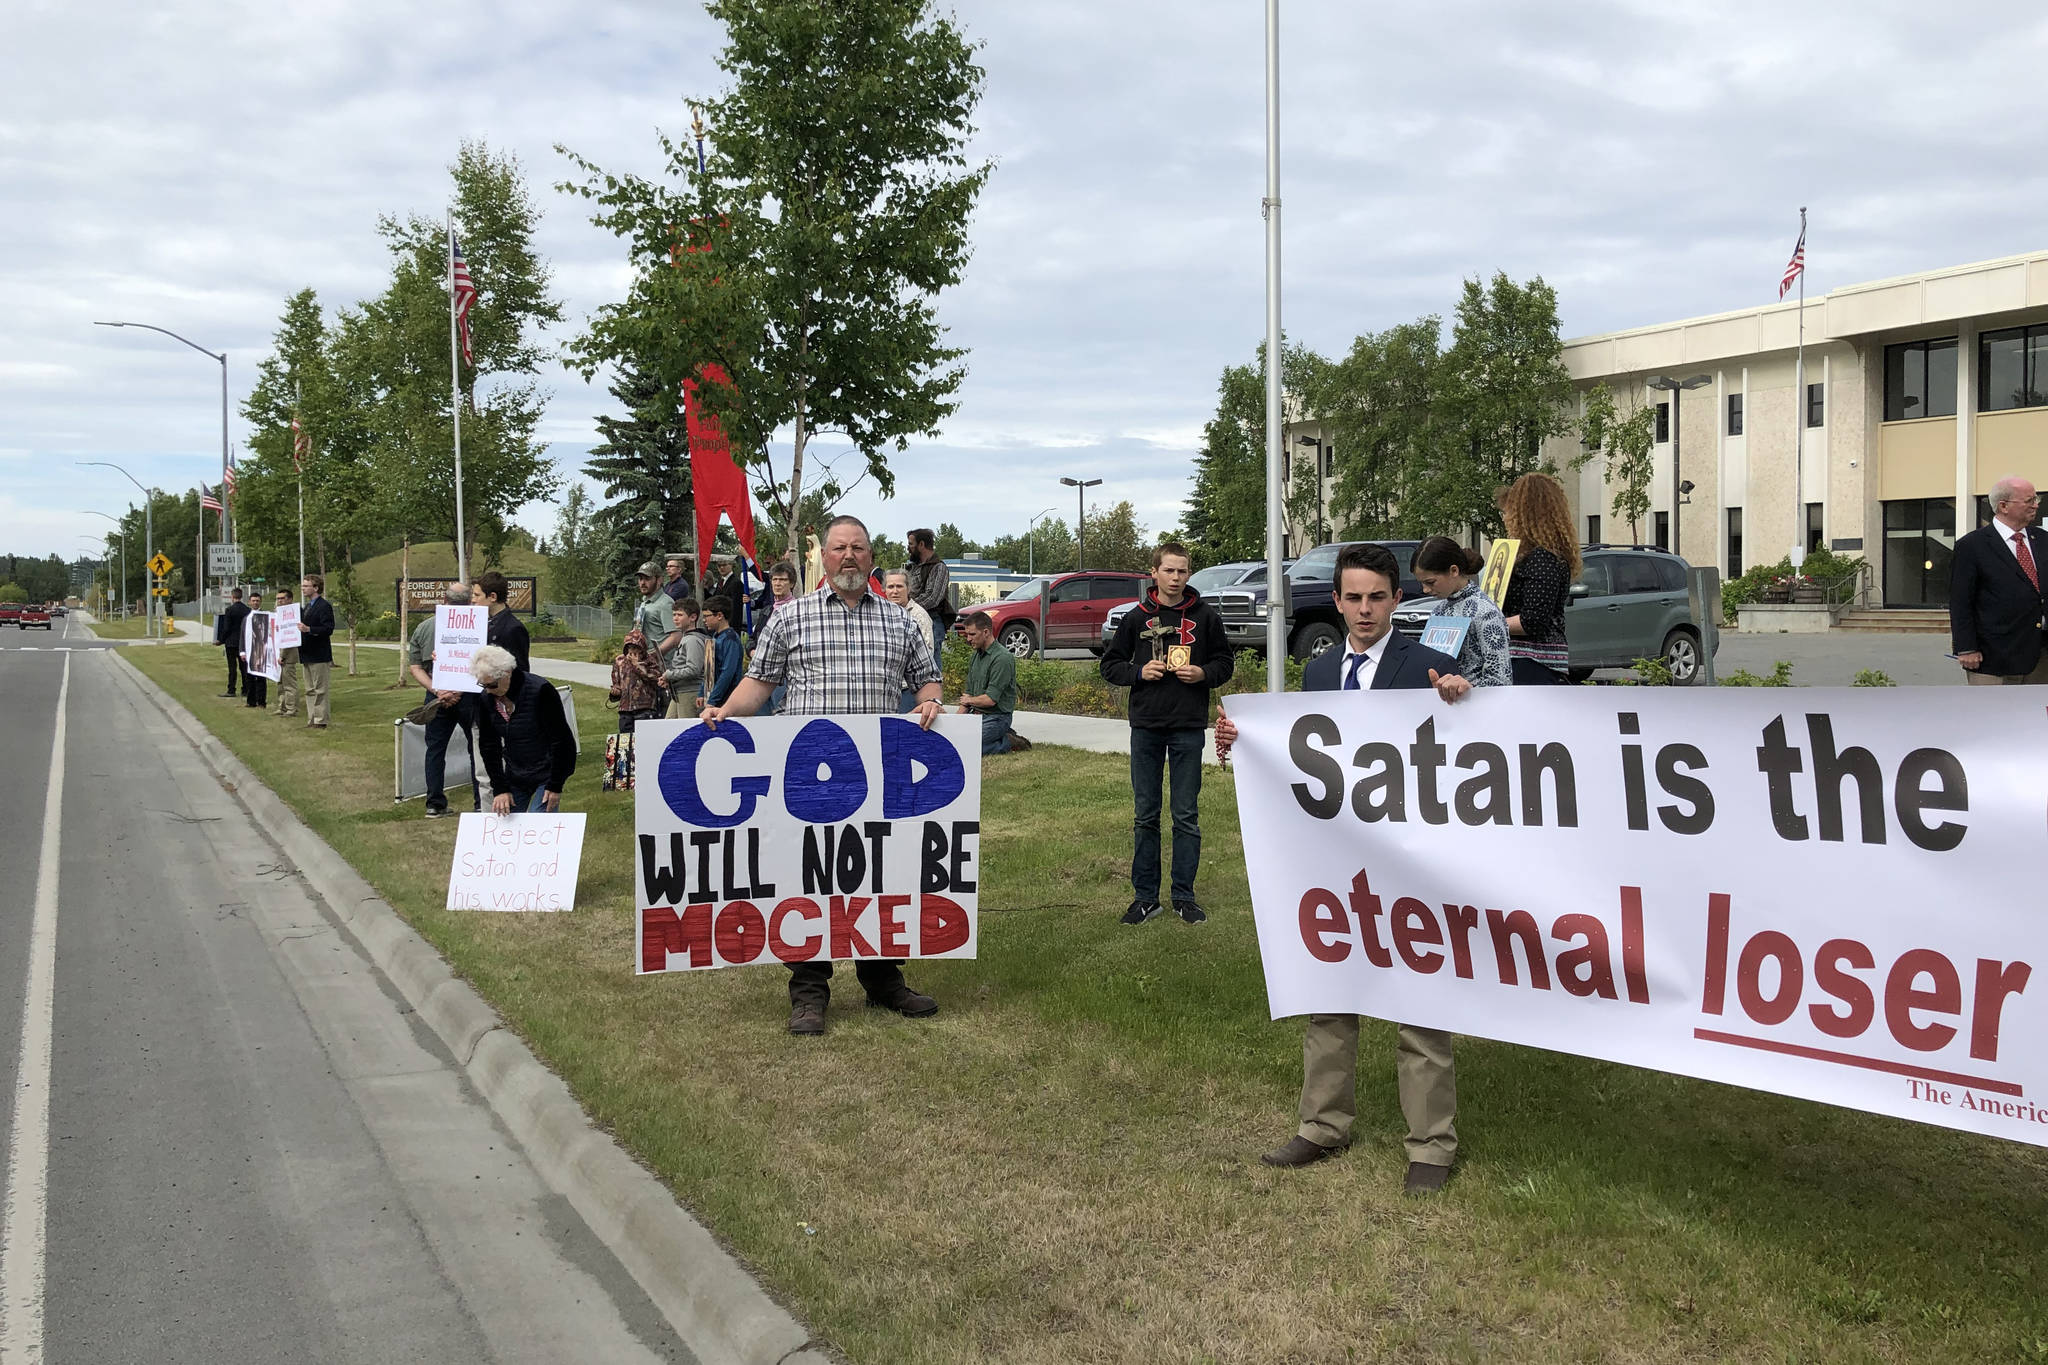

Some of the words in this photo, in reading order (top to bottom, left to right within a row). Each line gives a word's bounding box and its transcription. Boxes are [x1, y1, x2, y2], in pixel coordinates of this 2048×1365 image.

[402, 582, 436, 591] EORGE
[447, 608, 477, 630] Honk
[1427, 629, 1460, 645] KNOW
[658, 717, 966, 828] GOD
[1289, 713, 1578, 828] Satan
[1617, 711, 1716, 836] is
[1757, 712, 1969, 852] the
[482, 815, 566, 856] Reject
[461, 851, 517, 877] Satan
[527, 852, 559, 877] and
[639, 828, 776, 905] WILL
[802, 821, 892, 895] NOT
[920, 821, 980, 893] BE
[453, 884, 481, 909] his
[491, 883, 560, 912] works
[642, 894, 970, 973] MOCKED
[1298, 868, 1650, 1005] eternal
[1702, 892, 2032, 1063] loser
[1906, 1078, 1952, 1106] The
[1959, 1089, 2048, 1124] Americ
